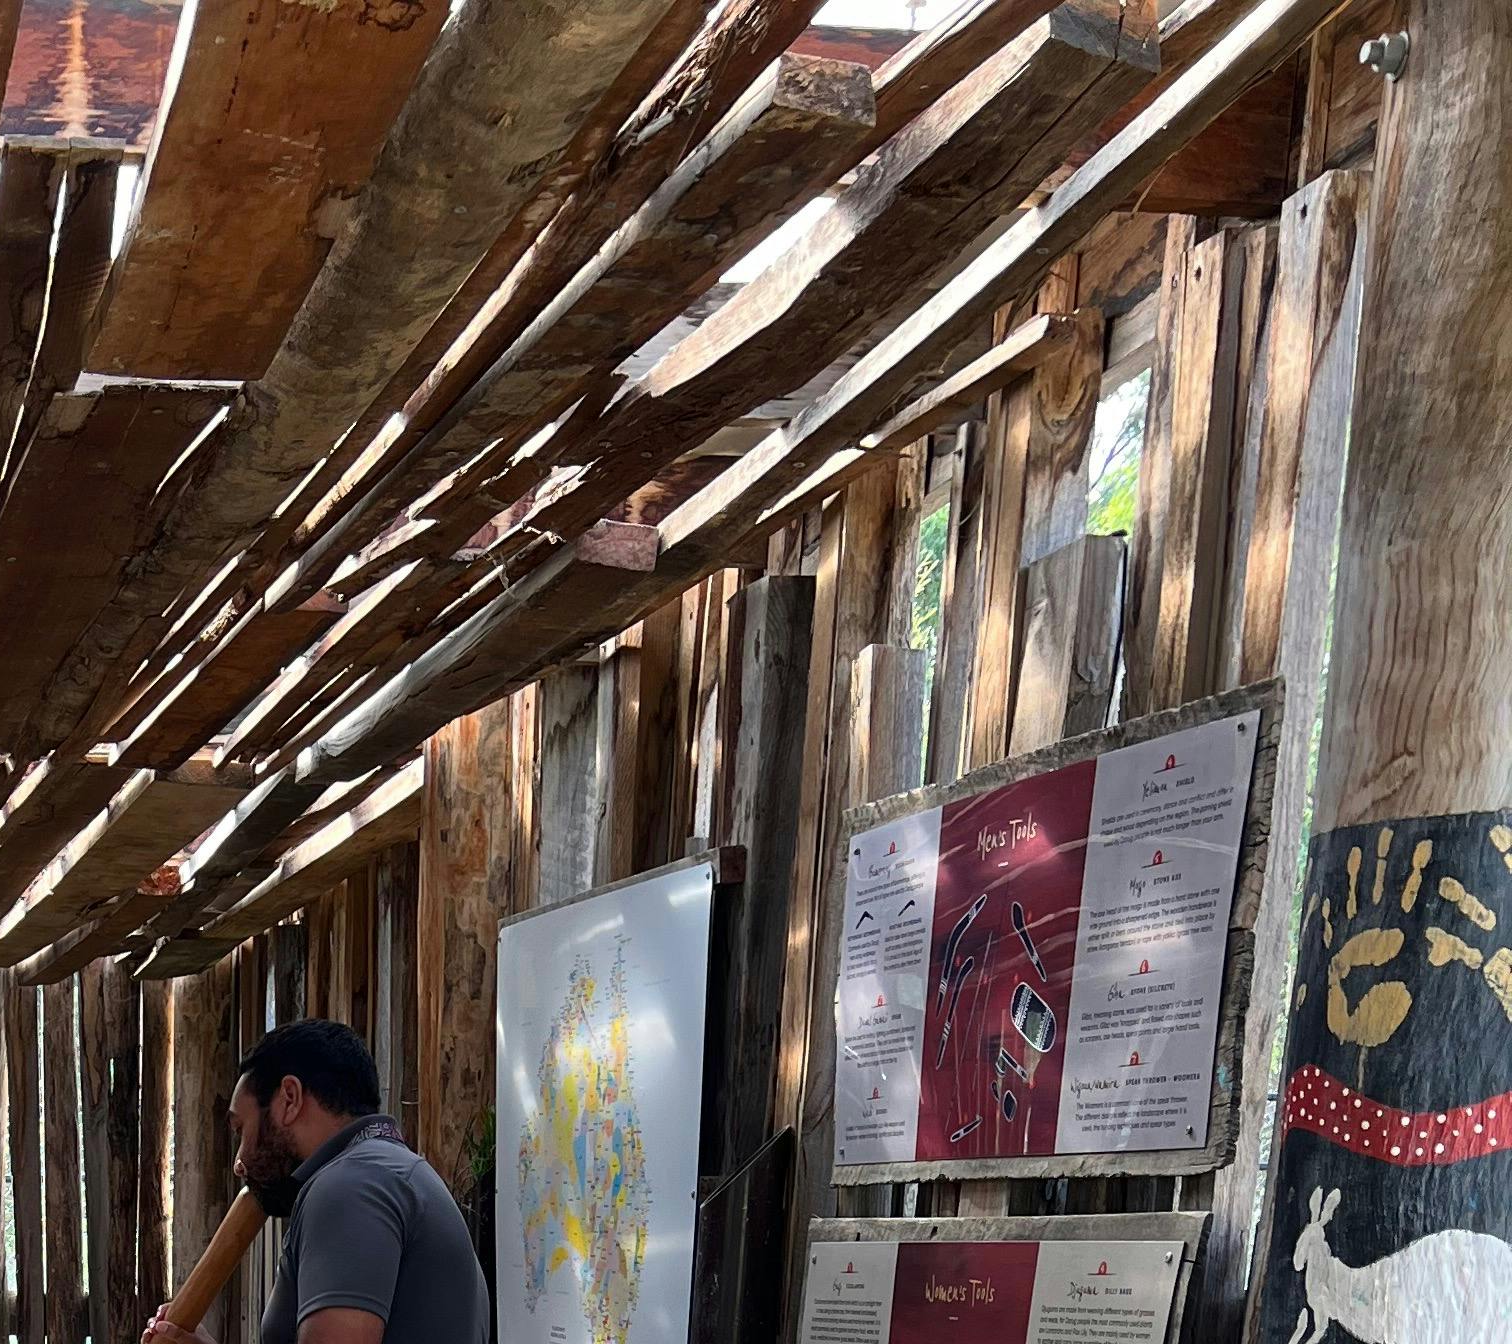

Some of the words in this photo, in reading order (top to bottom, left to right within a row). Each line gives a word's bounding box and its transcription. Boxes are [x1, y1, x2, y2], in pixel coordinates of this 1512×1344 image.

[977, 826, 1006, 860] Men's
[1009, 812, 1037, 849] Tools
[925, 1274, 967, 1302] Women's
[969, 1276, 995, 1307] Tools
